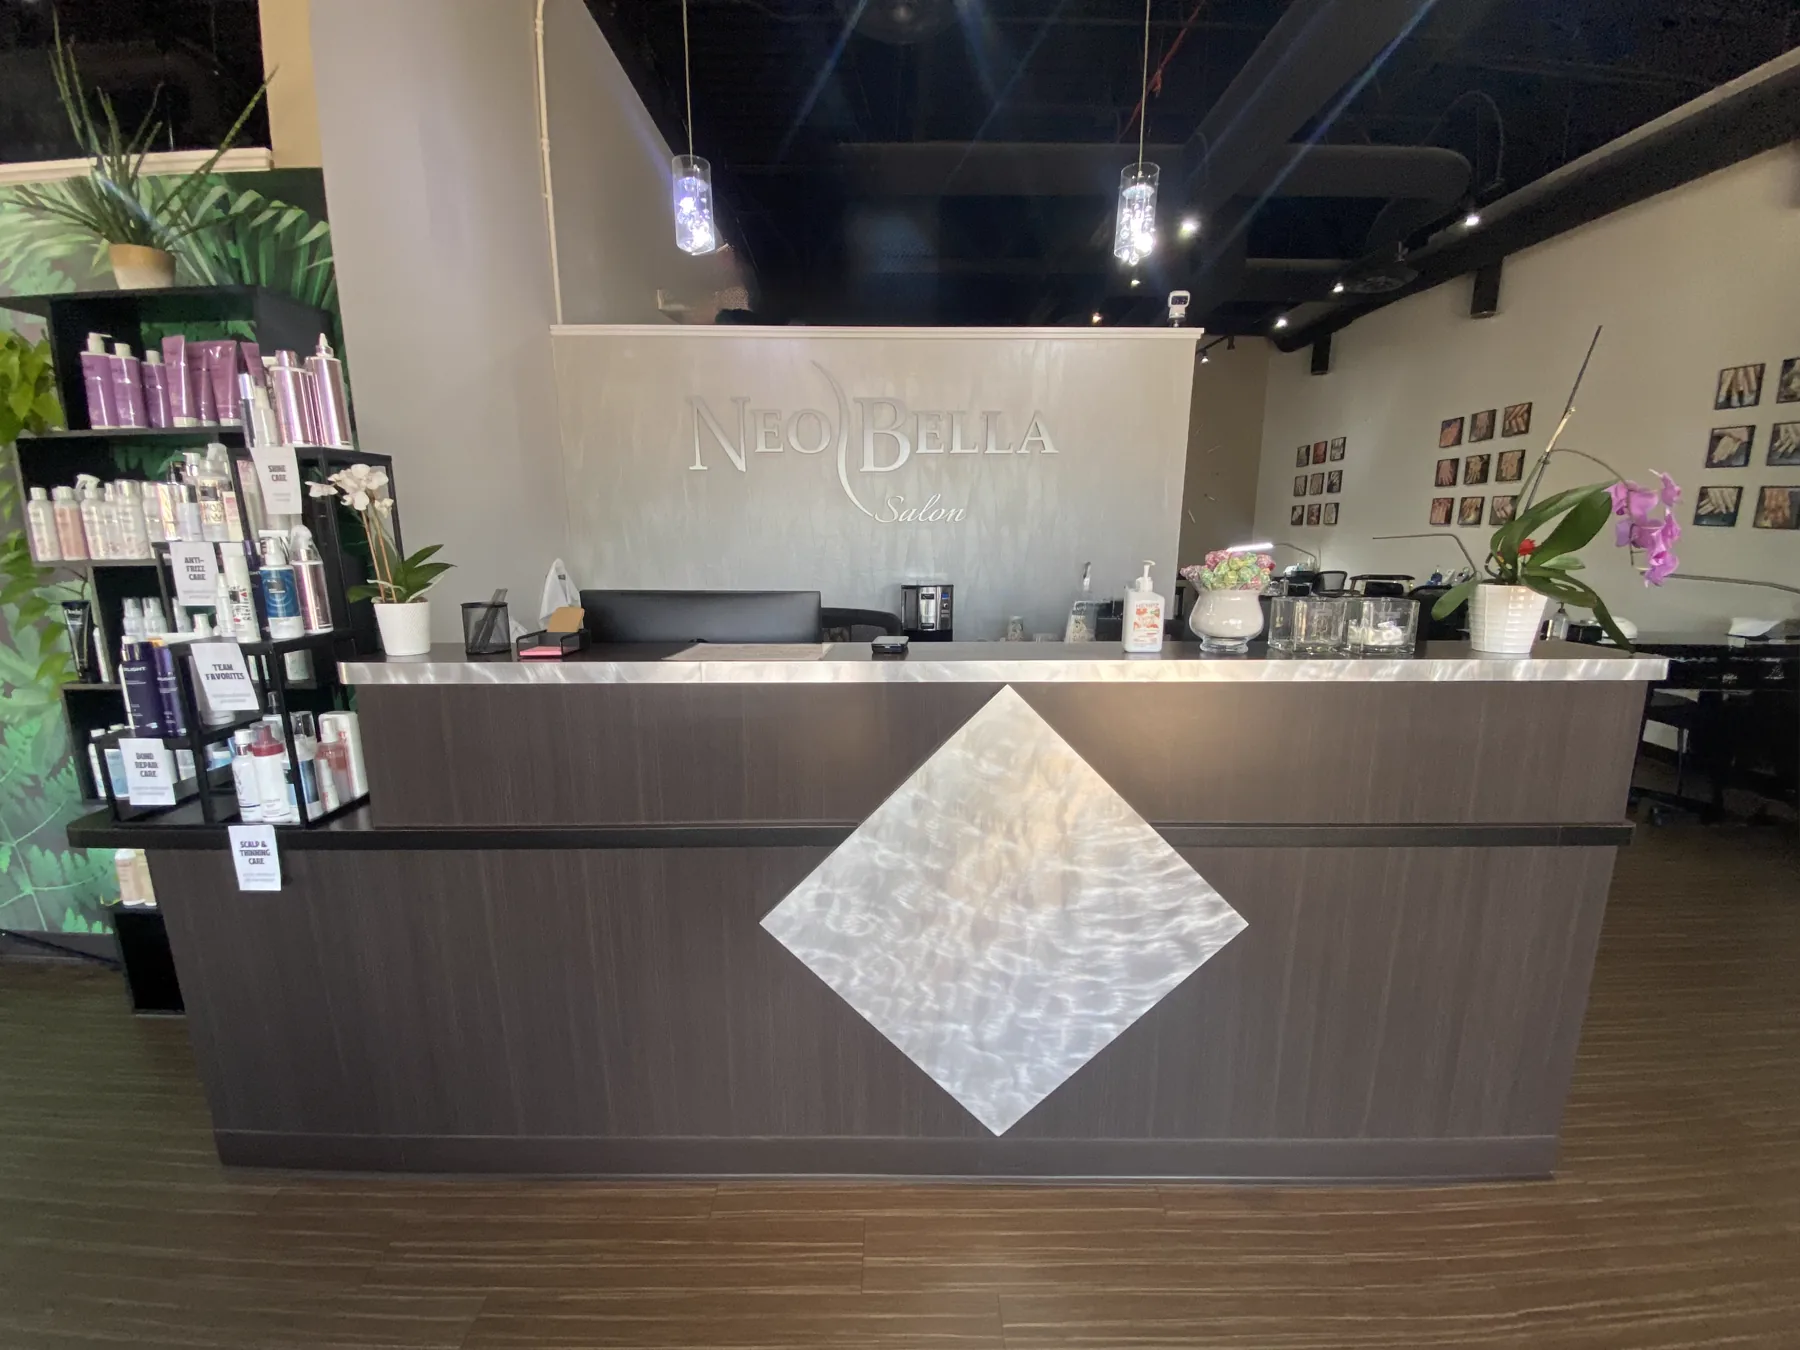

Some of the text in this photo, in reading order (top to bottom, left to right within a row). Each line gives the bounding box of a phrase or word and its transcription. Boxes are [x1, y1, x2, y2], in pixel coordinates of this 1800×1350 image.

[853, 396, 1060, 473] BELLA
[267, 465, 287, 473] SHINE
[271, 474, 288, 482] CARE
[872, 493, 966, 523] Salon
[186, 565, 206, 573] FRIZZ
[212, 663, 234, 671] TEAM
[205, 672, 245, 681] FAVORITES
[135, 752, 155, 760] BOND
[134, 761, 159, 769] REPAIR
[139, 770, 158, 778] CARE
[239, 840, 268, 848] SCALP &
[239, 849, 271, 857] THINNING
[248, 857, 265, 865] CARE
